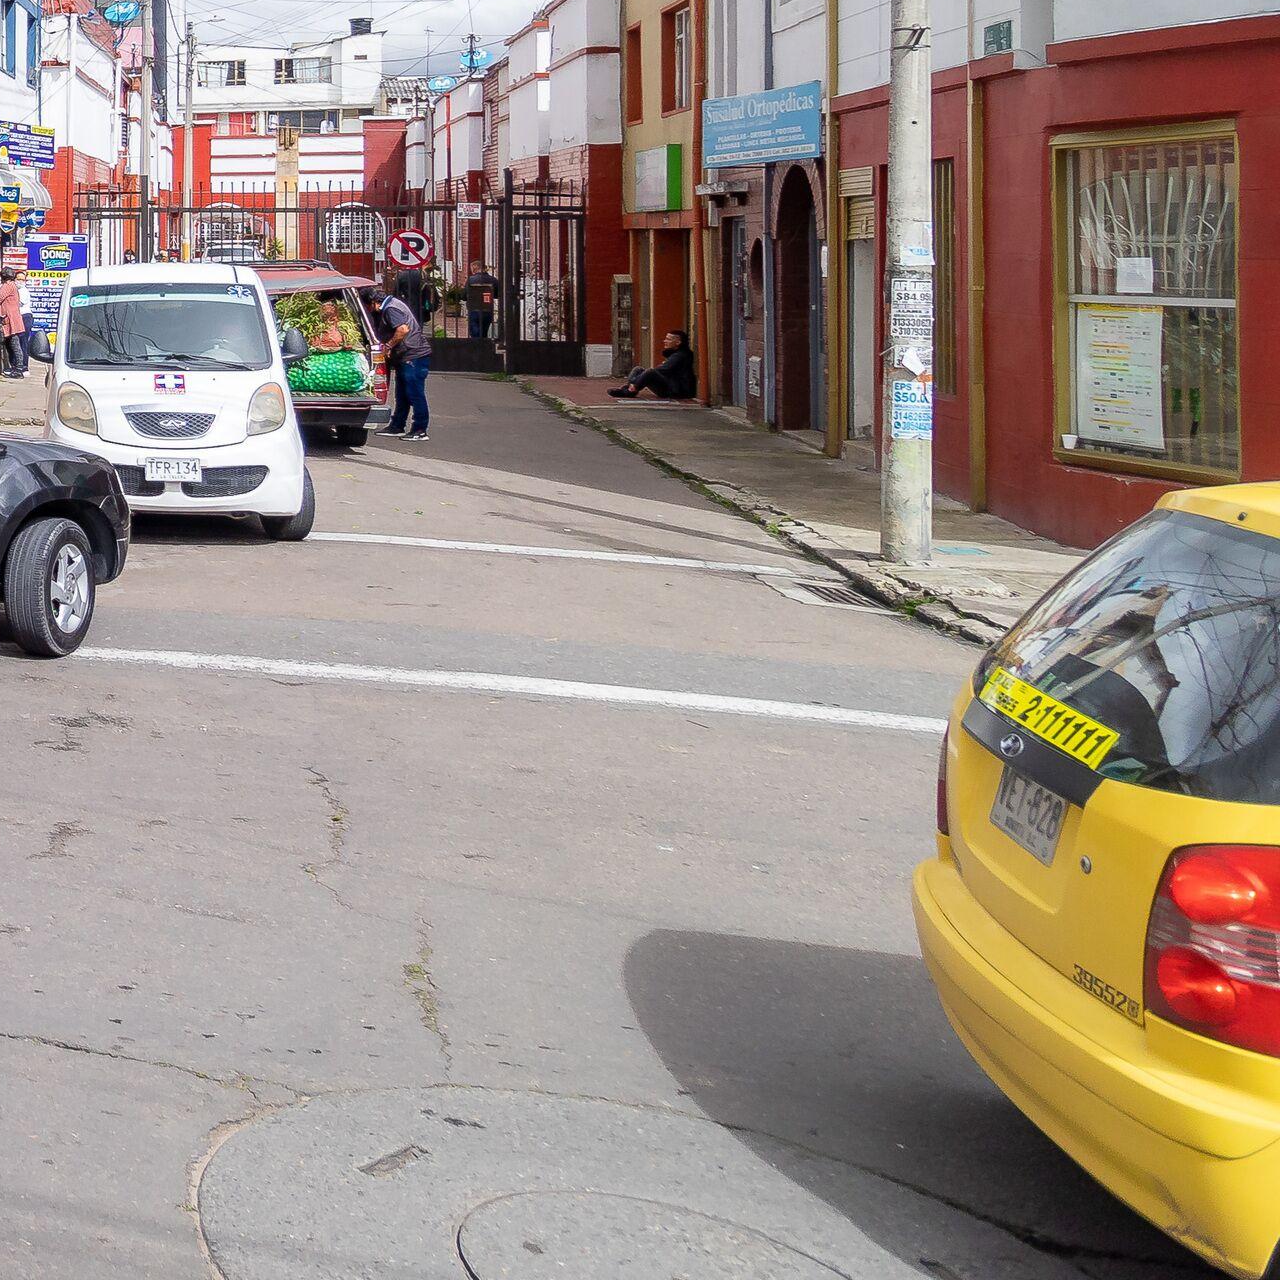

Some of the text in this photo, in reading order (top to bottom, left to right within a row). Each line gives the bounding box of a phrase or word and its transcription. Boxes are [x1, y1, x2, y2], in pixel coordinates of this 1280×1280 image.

[42, 250, 70, 260] DONDE
[894, 382, 912, 390] EPS
[148, 460, 199, 474] TFR-134
[1072, 962, 1129, 1015] 39552
